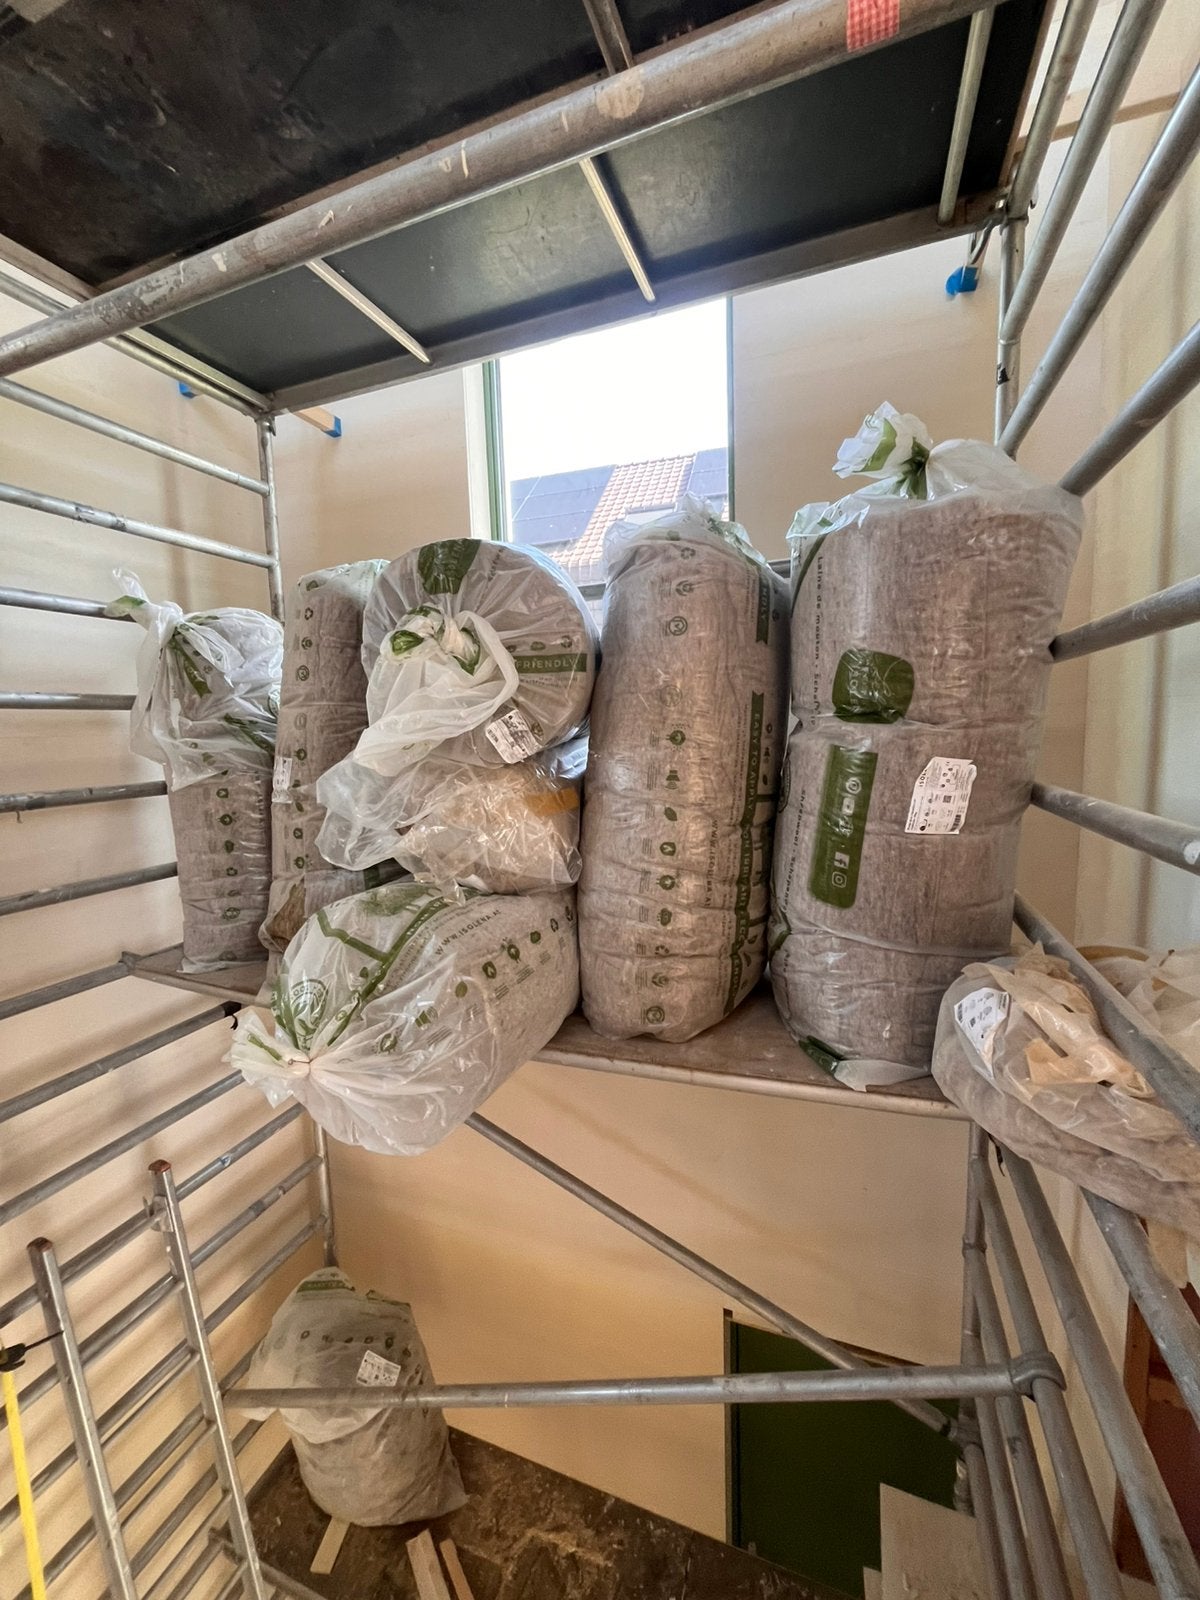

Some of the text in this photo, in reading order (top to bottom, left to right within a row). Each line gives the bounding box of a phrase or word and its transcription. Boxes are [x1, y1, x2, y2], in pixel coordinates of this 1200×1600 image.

[816, 556, 824, 590] Laine
[815, 595, 823, 609] de
[814, 614, 822, 660] mouton
[516, 658, 577, 669] FRIENDLY
[752, 713, 761, 744] EASY
[750, 750, 758, 766] TO
[748, 771, 757, 811] APPLY
